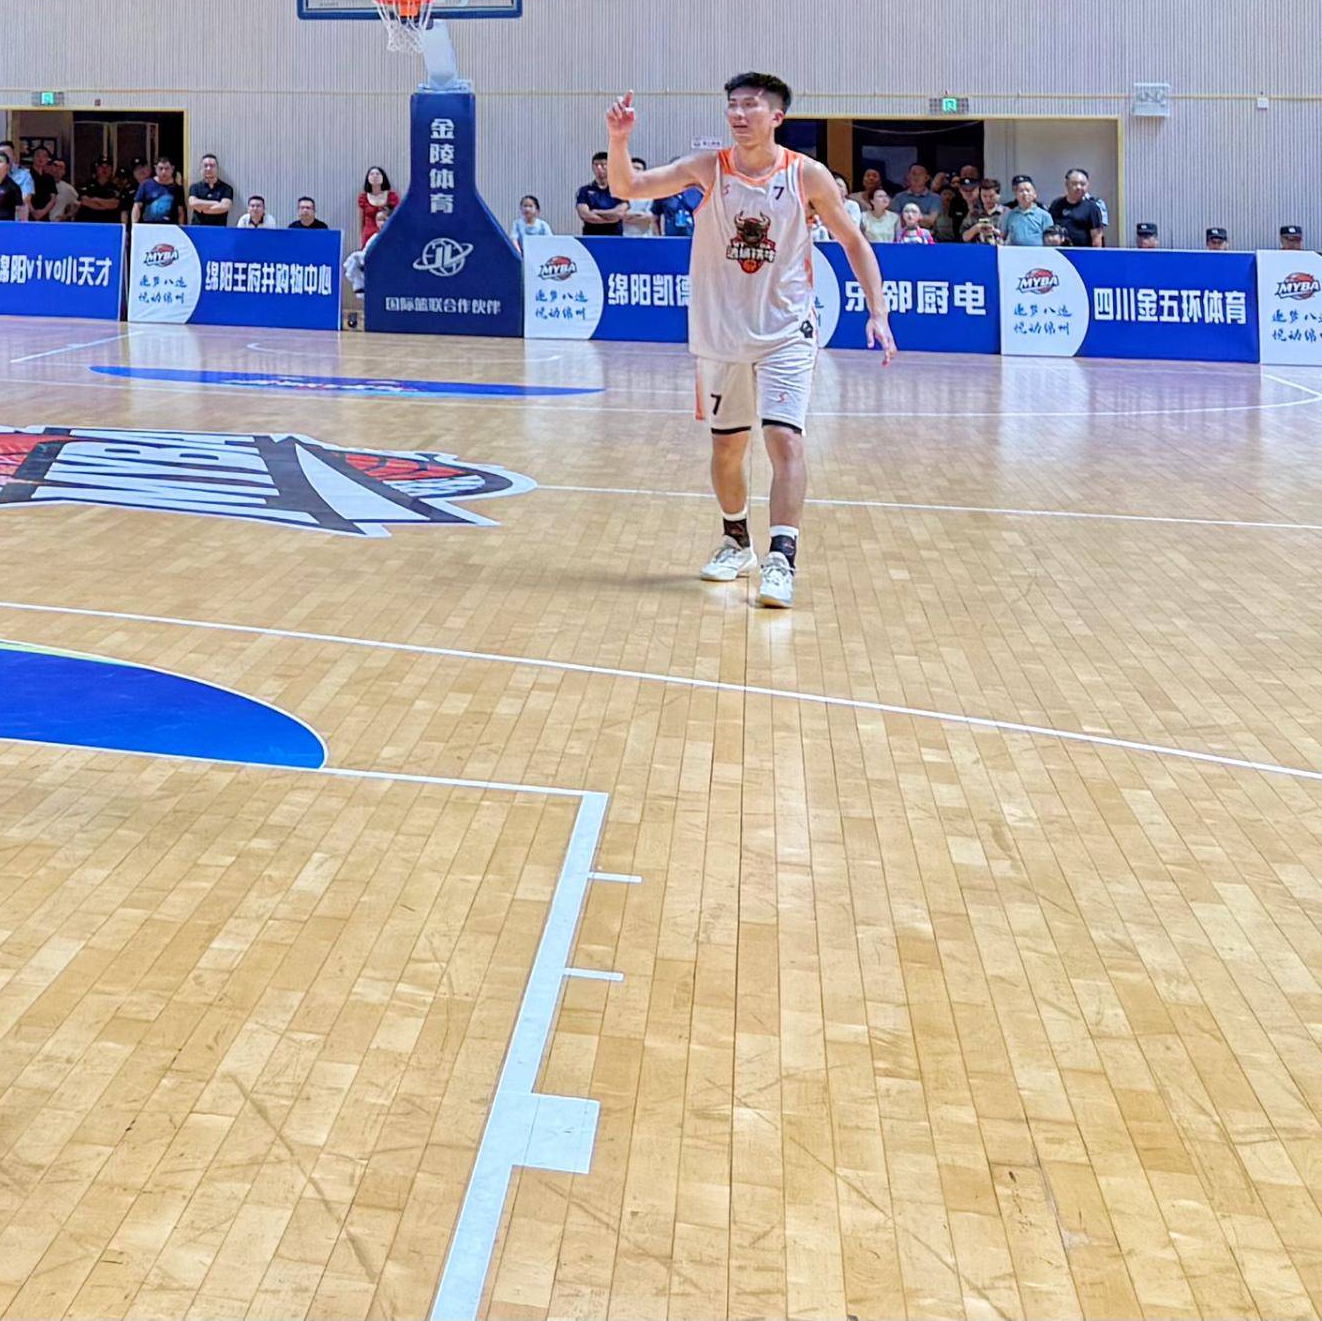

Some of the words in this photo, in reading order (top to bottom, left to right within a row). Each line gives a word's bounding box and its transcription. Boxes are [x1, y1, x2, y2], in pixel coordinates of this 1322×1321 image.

[429, 118, 455, 214] 金陵体育
[773, 185, 785, 201] 7
[204, 260, 332, 296] 绵阳王府井购物中心
[538, 260, 578, 279] MYBA
[1018, 275, 1059, 293] MYBA
[1277, 280, 1322, 299] MYBA
[385, 295, 501, 316] 国际篮联合作伙伴
[1093, 286, 1246, 325] 四川金五环体育
[709, 393, 722, 416] 7
